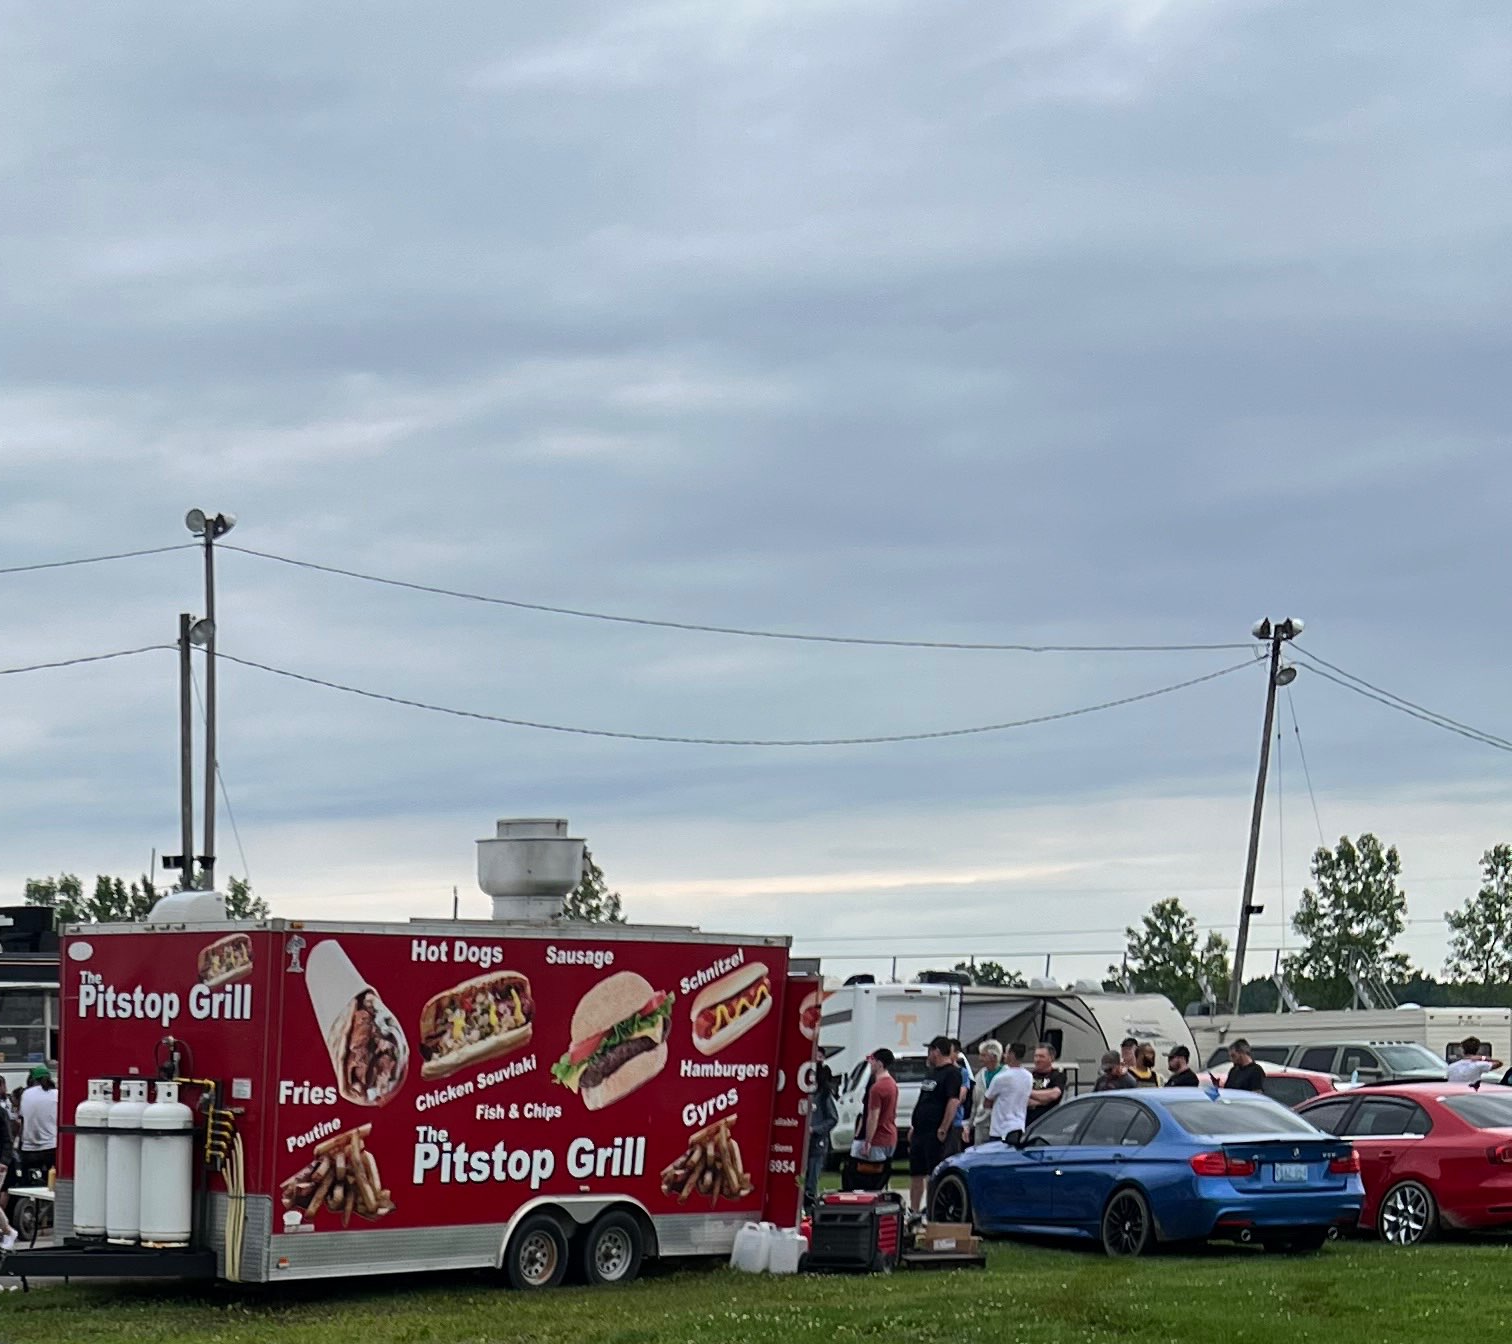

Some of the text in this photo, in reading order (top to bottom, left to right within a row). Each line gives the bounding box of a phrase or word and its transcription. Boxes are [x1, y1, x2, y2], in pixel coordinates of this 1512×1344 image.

[411, 939, 503, 968] Hot Dogs
[545, 945, 614, 969] Sausage
[79, 970, 103, 985] The
[680, 947, 745, 995] Schnitzel
[78, 983, 252, 1028] Pitstop Grill
[415, 1054, 537, 1111] Chicken Souvlaki
[680, 1060, 769, 1081] Hamburgers
[279, 1080, 338, 1105] Fries
[475, 1102, 562, 1121] Fish & Chips
[682, 1088, 739, 1127] Gyros
[286, 1117, 341, 1153] Poutine
[416, 1125, 448, 1143] The
[413, 1136, 646, 1190] Pitstop Grill
